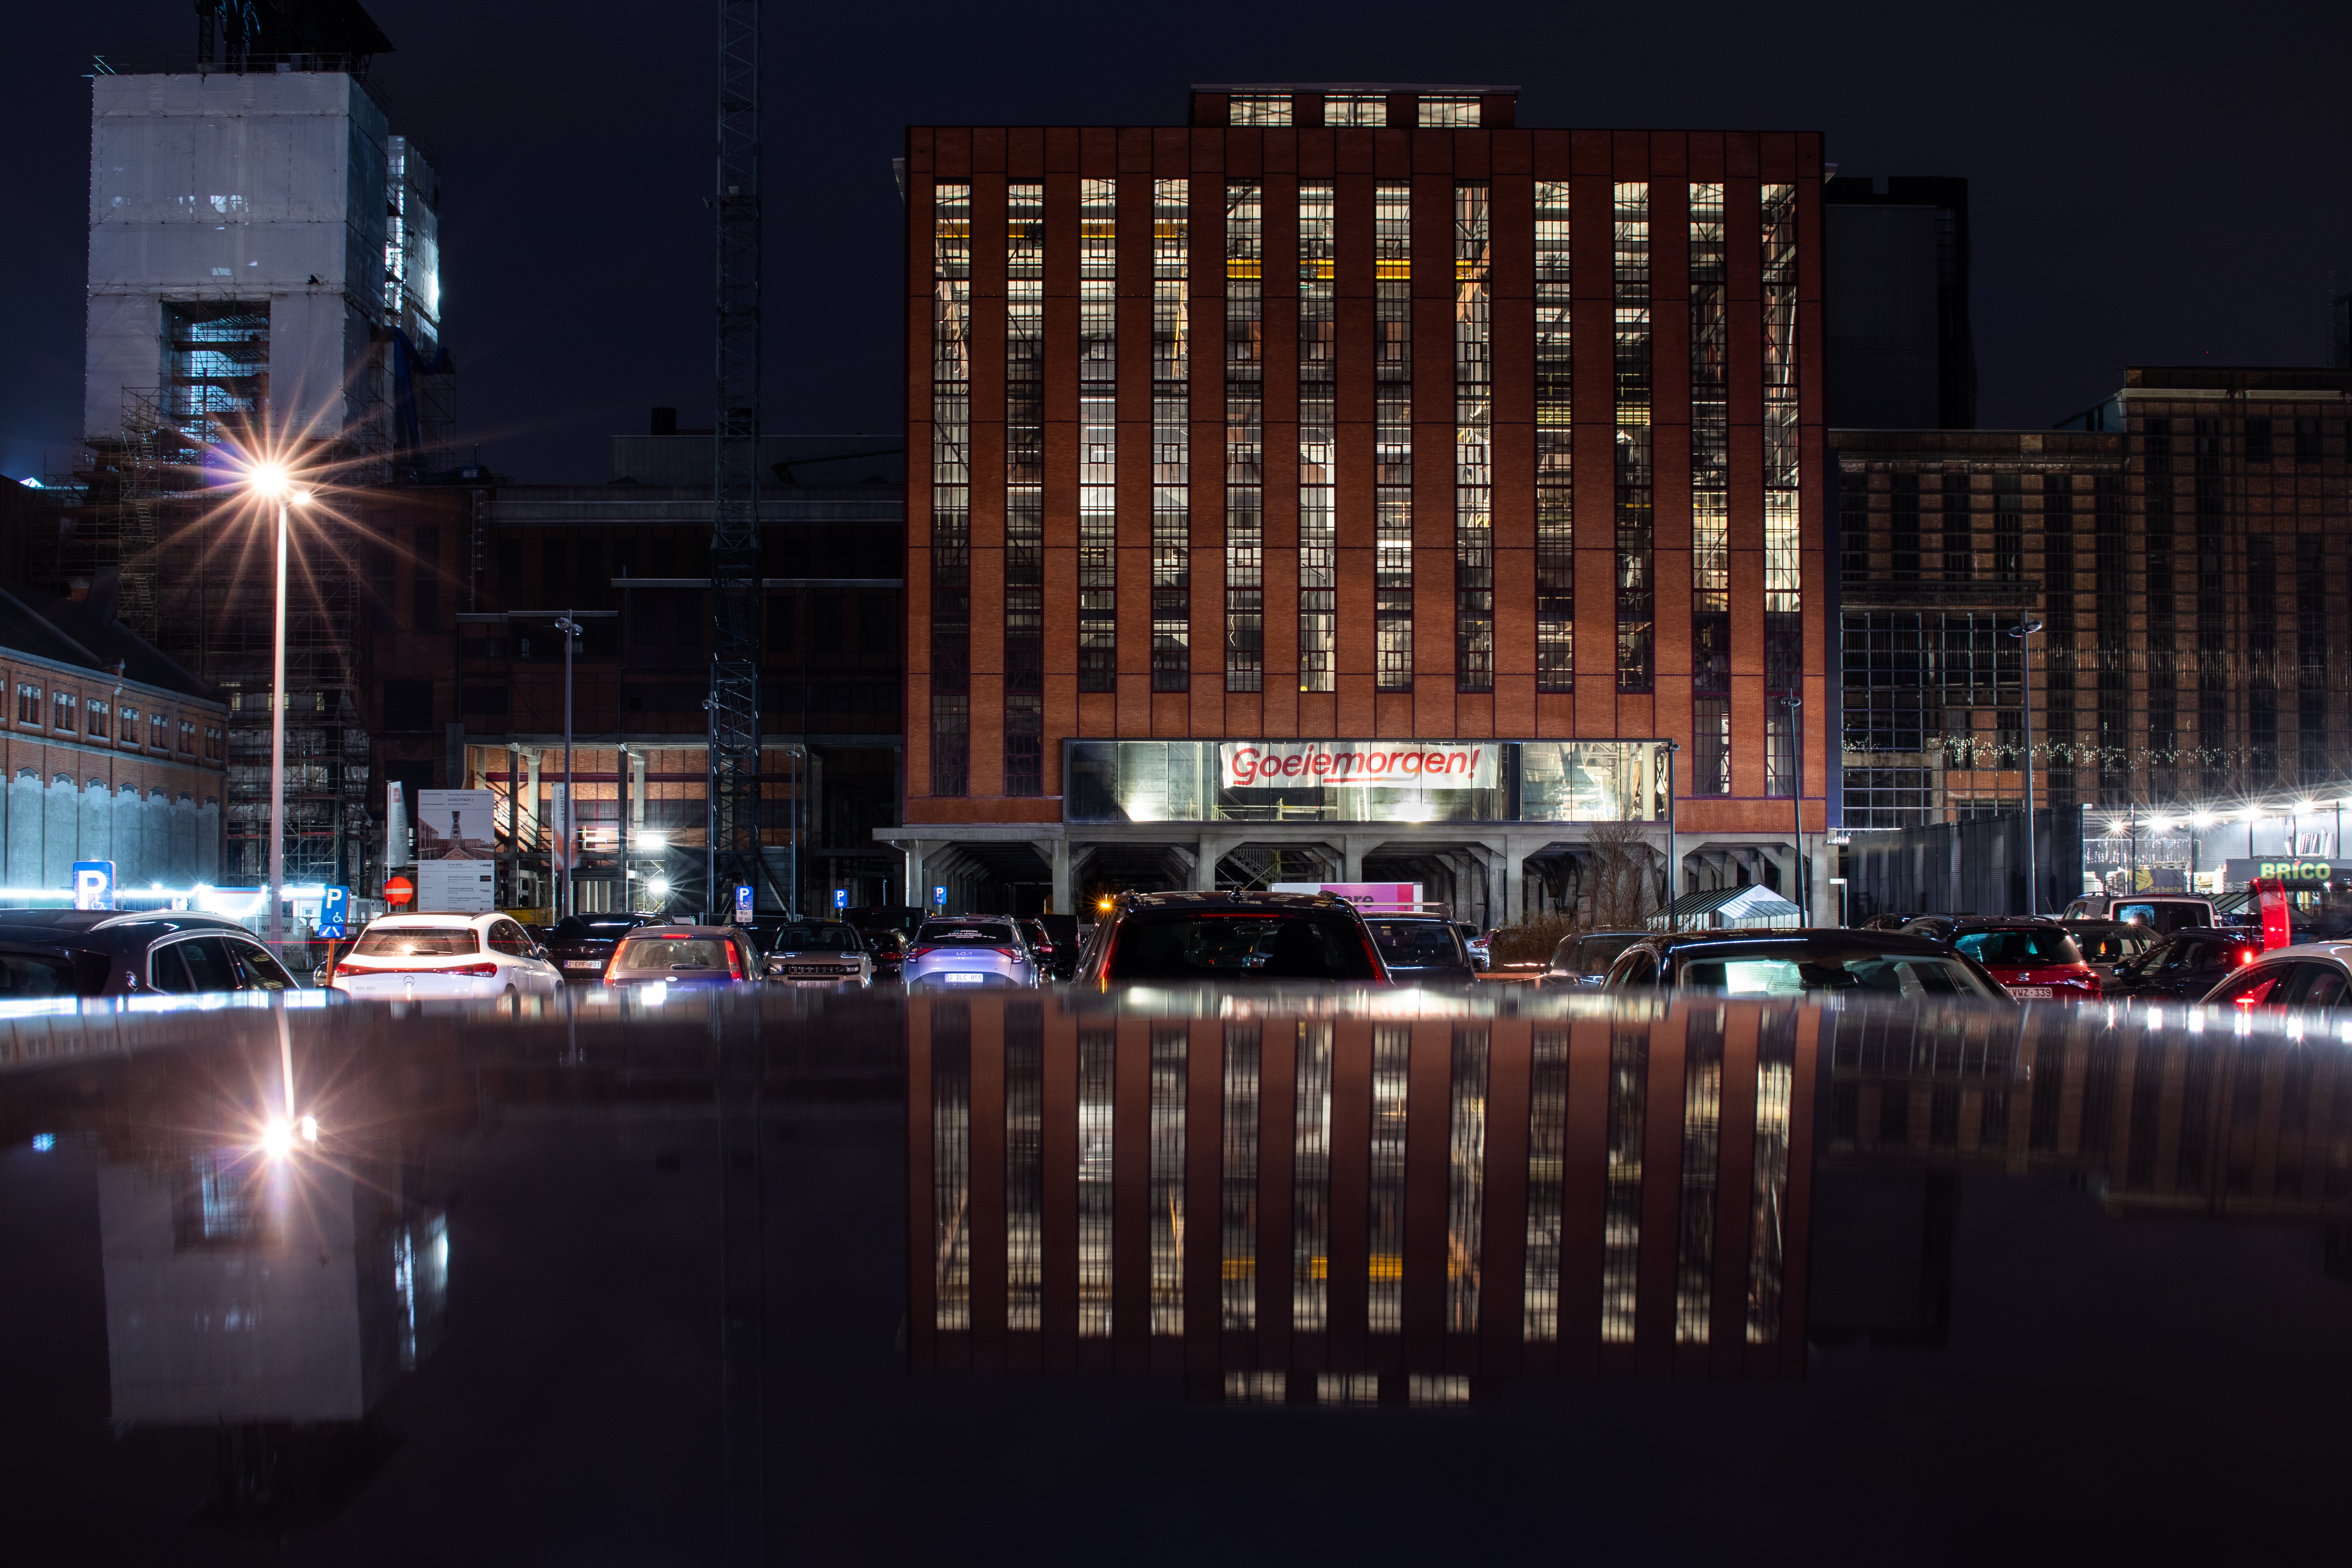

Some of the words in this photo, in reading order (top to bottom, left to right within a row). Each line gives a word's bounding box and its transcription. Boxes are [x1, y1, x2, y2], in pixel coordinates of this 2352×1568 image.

[1232, 744, 1480, 785] Goeiemorgen!
[79, 871, 107, 909] P
[327, 888, 342, 908] P
[740, 888, 749, 901] P
[837, 891, 844, 900] P
[936, 887, 944, 897] P
